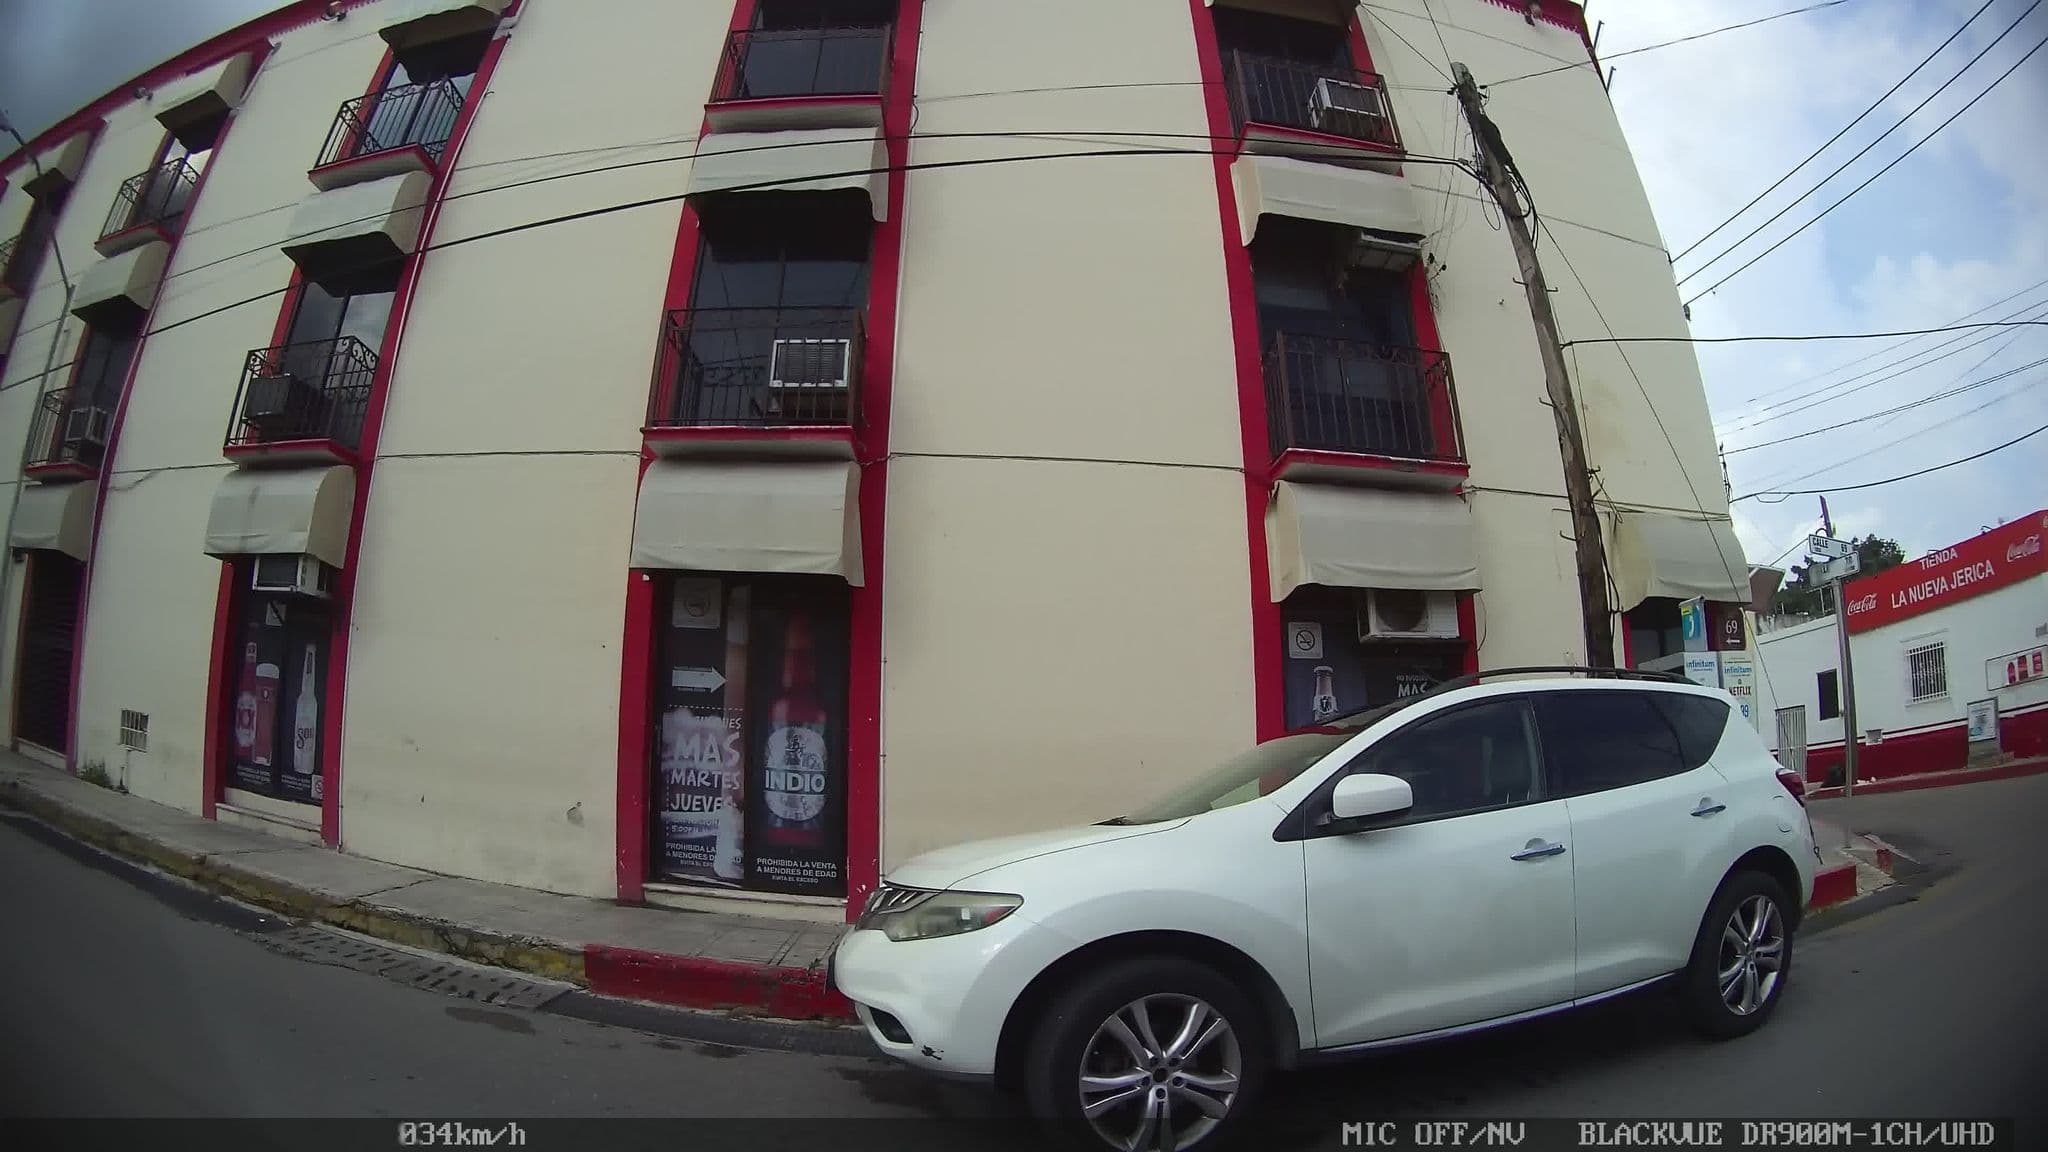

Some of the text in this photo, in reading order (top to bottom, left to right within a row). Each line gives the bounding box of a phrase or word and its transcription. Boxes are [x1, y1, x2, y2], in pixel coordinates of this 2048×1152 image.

[1812, 537, 1829, 549] CALLE
[1920, 548, 1958, 571] TIENDA
[1891, 559, 1995, 609] LA NUEVA JERICA
[1725, 620, 1738, 634] 69
[1729, 686, 1751, 696] NETFLIX
[673, 731, 741, 766] MAS
[670, 768, 741, 791] MARTES
[765, 769, 826, 793] INDIO
[666, 842, 706, 853] PROHIBIDA
[672, 851, 709, 861] MENORES
[757, 857, 837, 870] PROHIBIDA LA VENTA
[763, 867, 801, 876] MENORES
[802, 869, 814, 877] DE
[815, 870, 837, 878] EDAD
